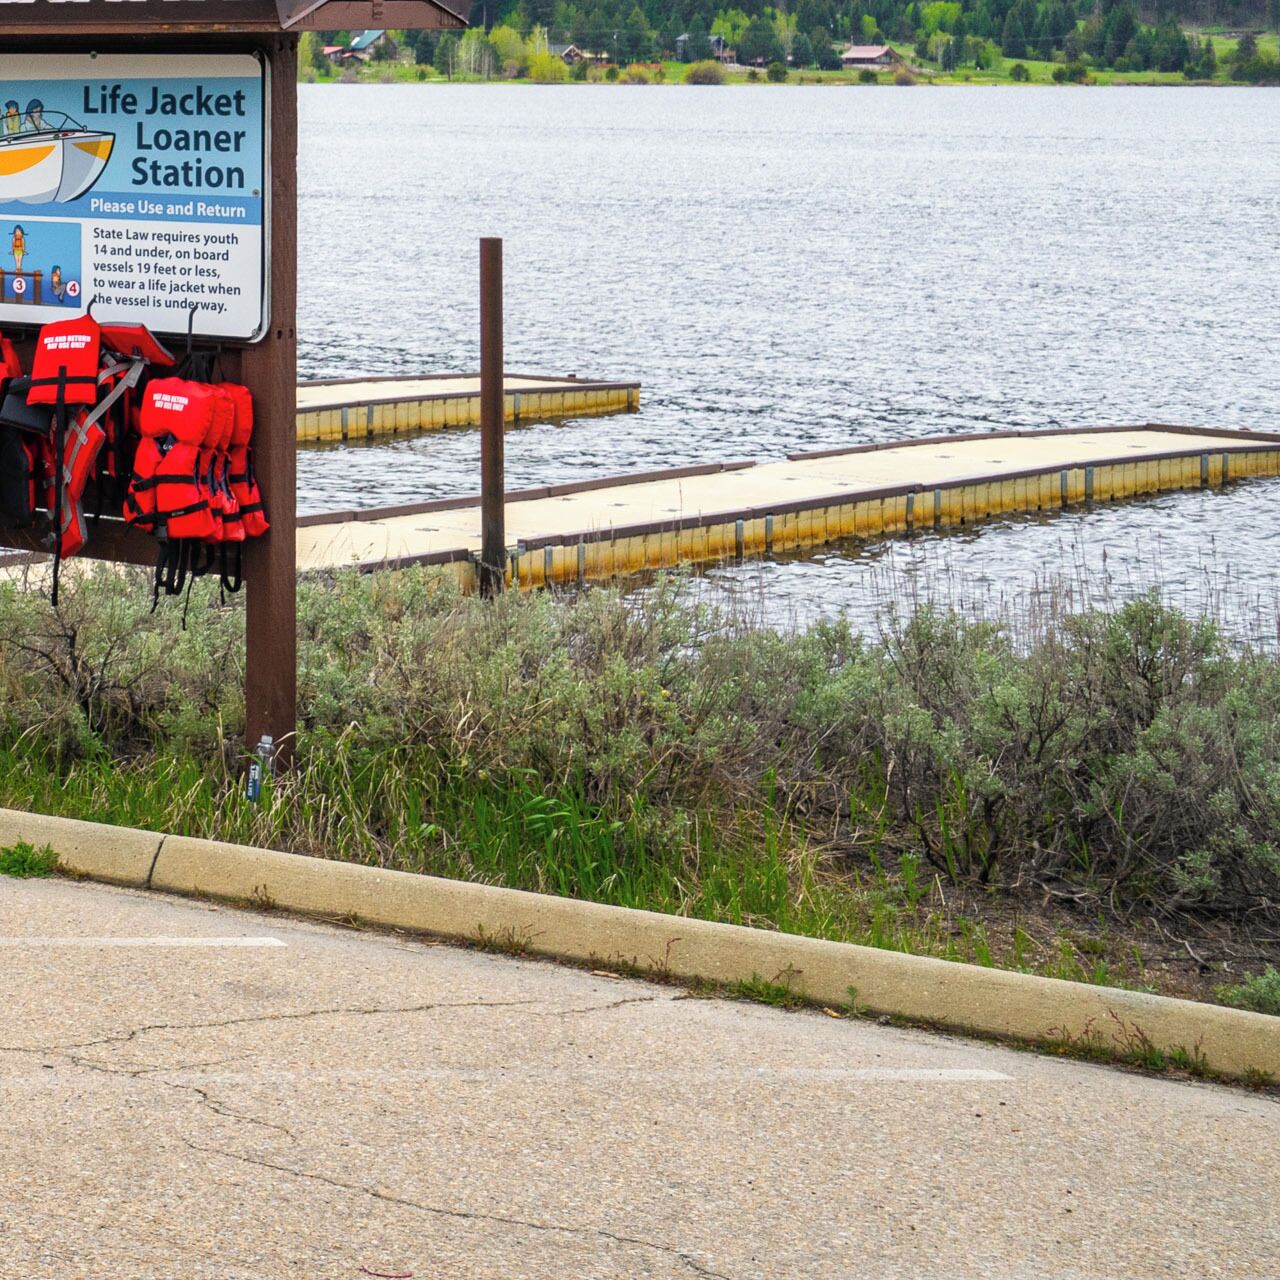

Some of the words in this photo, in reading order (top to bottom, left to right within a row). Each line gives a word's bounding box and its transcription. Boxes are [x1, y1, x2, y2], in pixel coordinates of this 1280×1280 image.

[83, 84, 138, 114] Life
[145, 85, 246, 116] Jacket
[136, 121, 246, 152] Loaner
[131, 156, 244, 189] Station
[90, 198, 134, 213] Please
[138, 200, 165, 214] Use
[166, 201, 193, 216] and
[197, 202, 246, 218] Return
[93, 227, 123, 239] State
[126, 228, 149, 241] Law
[151, 230, 201, 246] requires
[203, 233, 239, 246] youth
[94, 244, 107, 255] 14
[110, 245, 132, 256] and
[135, 246, 172, 259] under,
[175, 249, 190, 259] on
[193, 248, 229, 261] board
[93, 261, 134, 273] vessels
[137, 262, 150, 274] 19
[153, 262, 177, 275] feet
[179, 266, 192, 276] or
[195, 265, 221, 279] less,
[16, 279, 23, 290] 3
[69, 283, 77, 294] 4
[93, 278, 105, 288] to
[108, 280, 136, 289] wear
[138, 280, 145, 290] a
[148, 279, 167, 292] life
[168, 280, 205, 294] jacket
[208, 282, 241, 296] when
[93, 293, 112, 305] the
[115, 294, 150, 307] vessel
[152, 296, 162, 308] is
